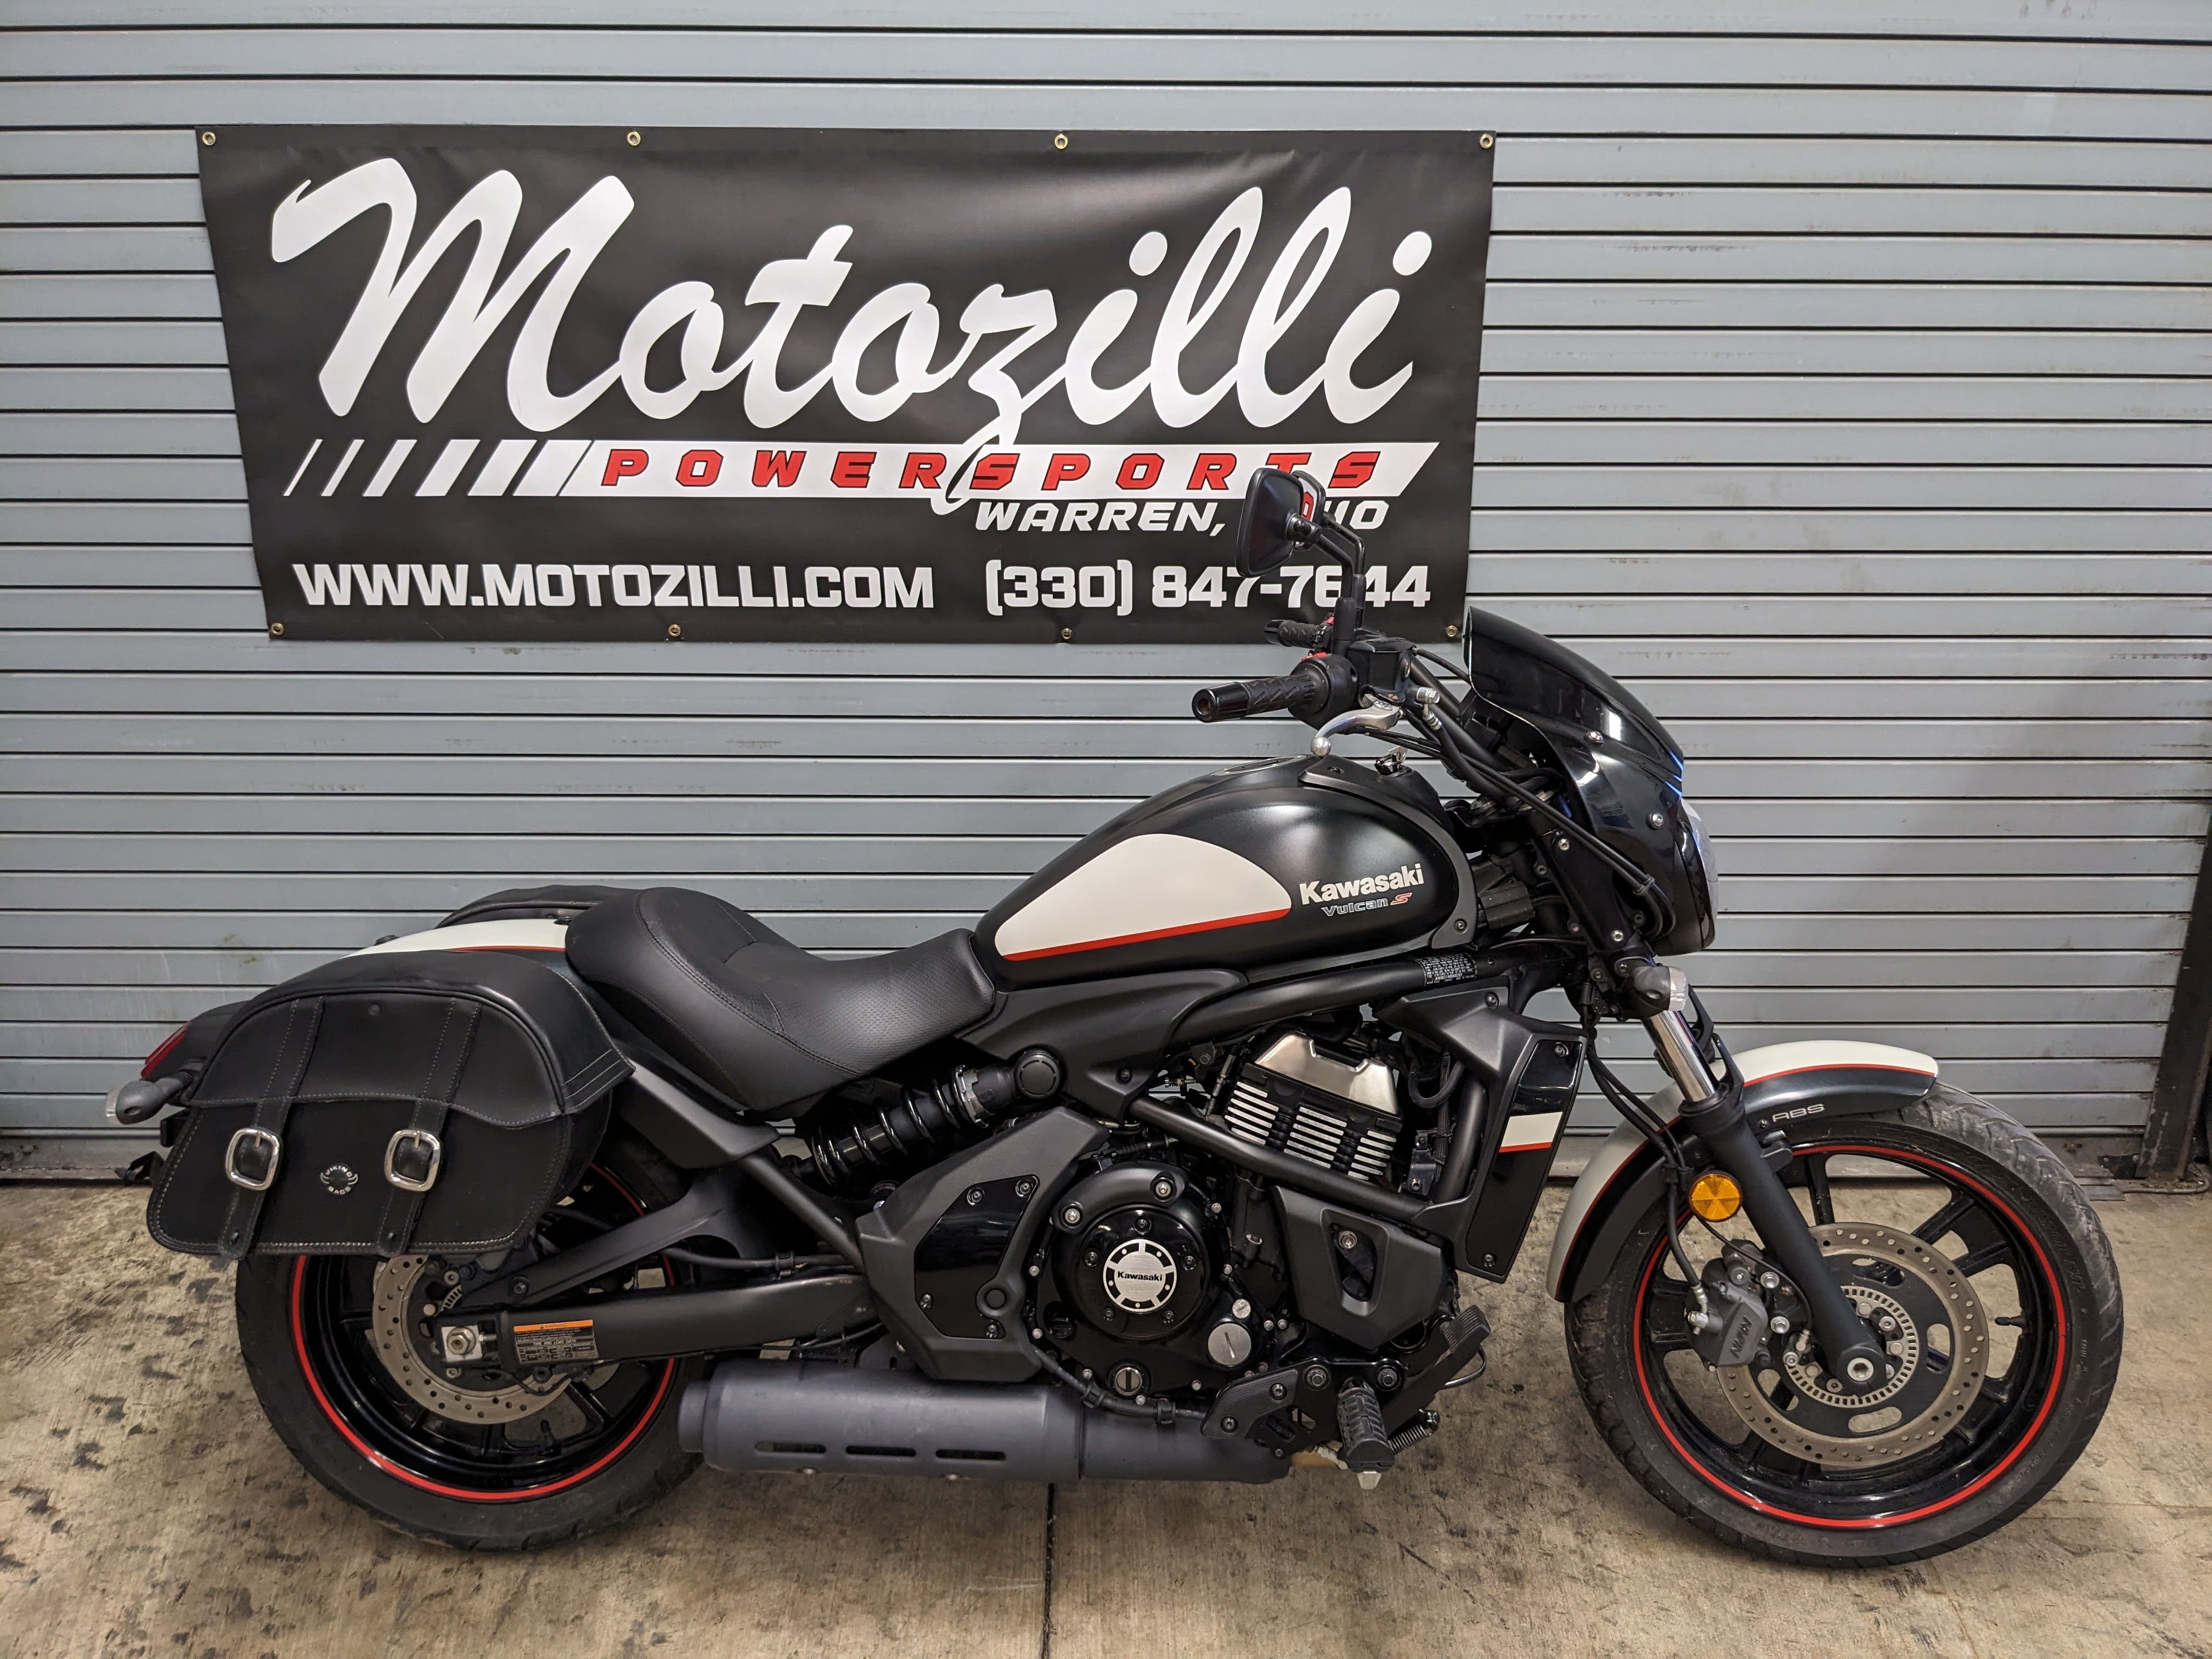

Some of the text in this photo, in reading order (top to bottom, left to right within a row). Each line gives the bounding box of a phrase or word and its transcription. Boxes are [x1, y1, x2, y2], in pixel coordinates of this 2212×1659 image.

[272, 157, 1432, 515] Motozilli
[601, 449, 1381, 490] POWERSPORTS
[975, 501, 1225, 537] WARREN,
[292, 563, 934, 608] WWW.MOTOZILLI.COM
[986, 559, 1133, 616] (330)
[1299, 864, 1424, 905] Kawasaki
[1321, 892, 1413, 916] Vulcan S
[1772, 1104, 1825, 1122] ABS
[1117, 1271, 1163, 1282] Kawasaki
